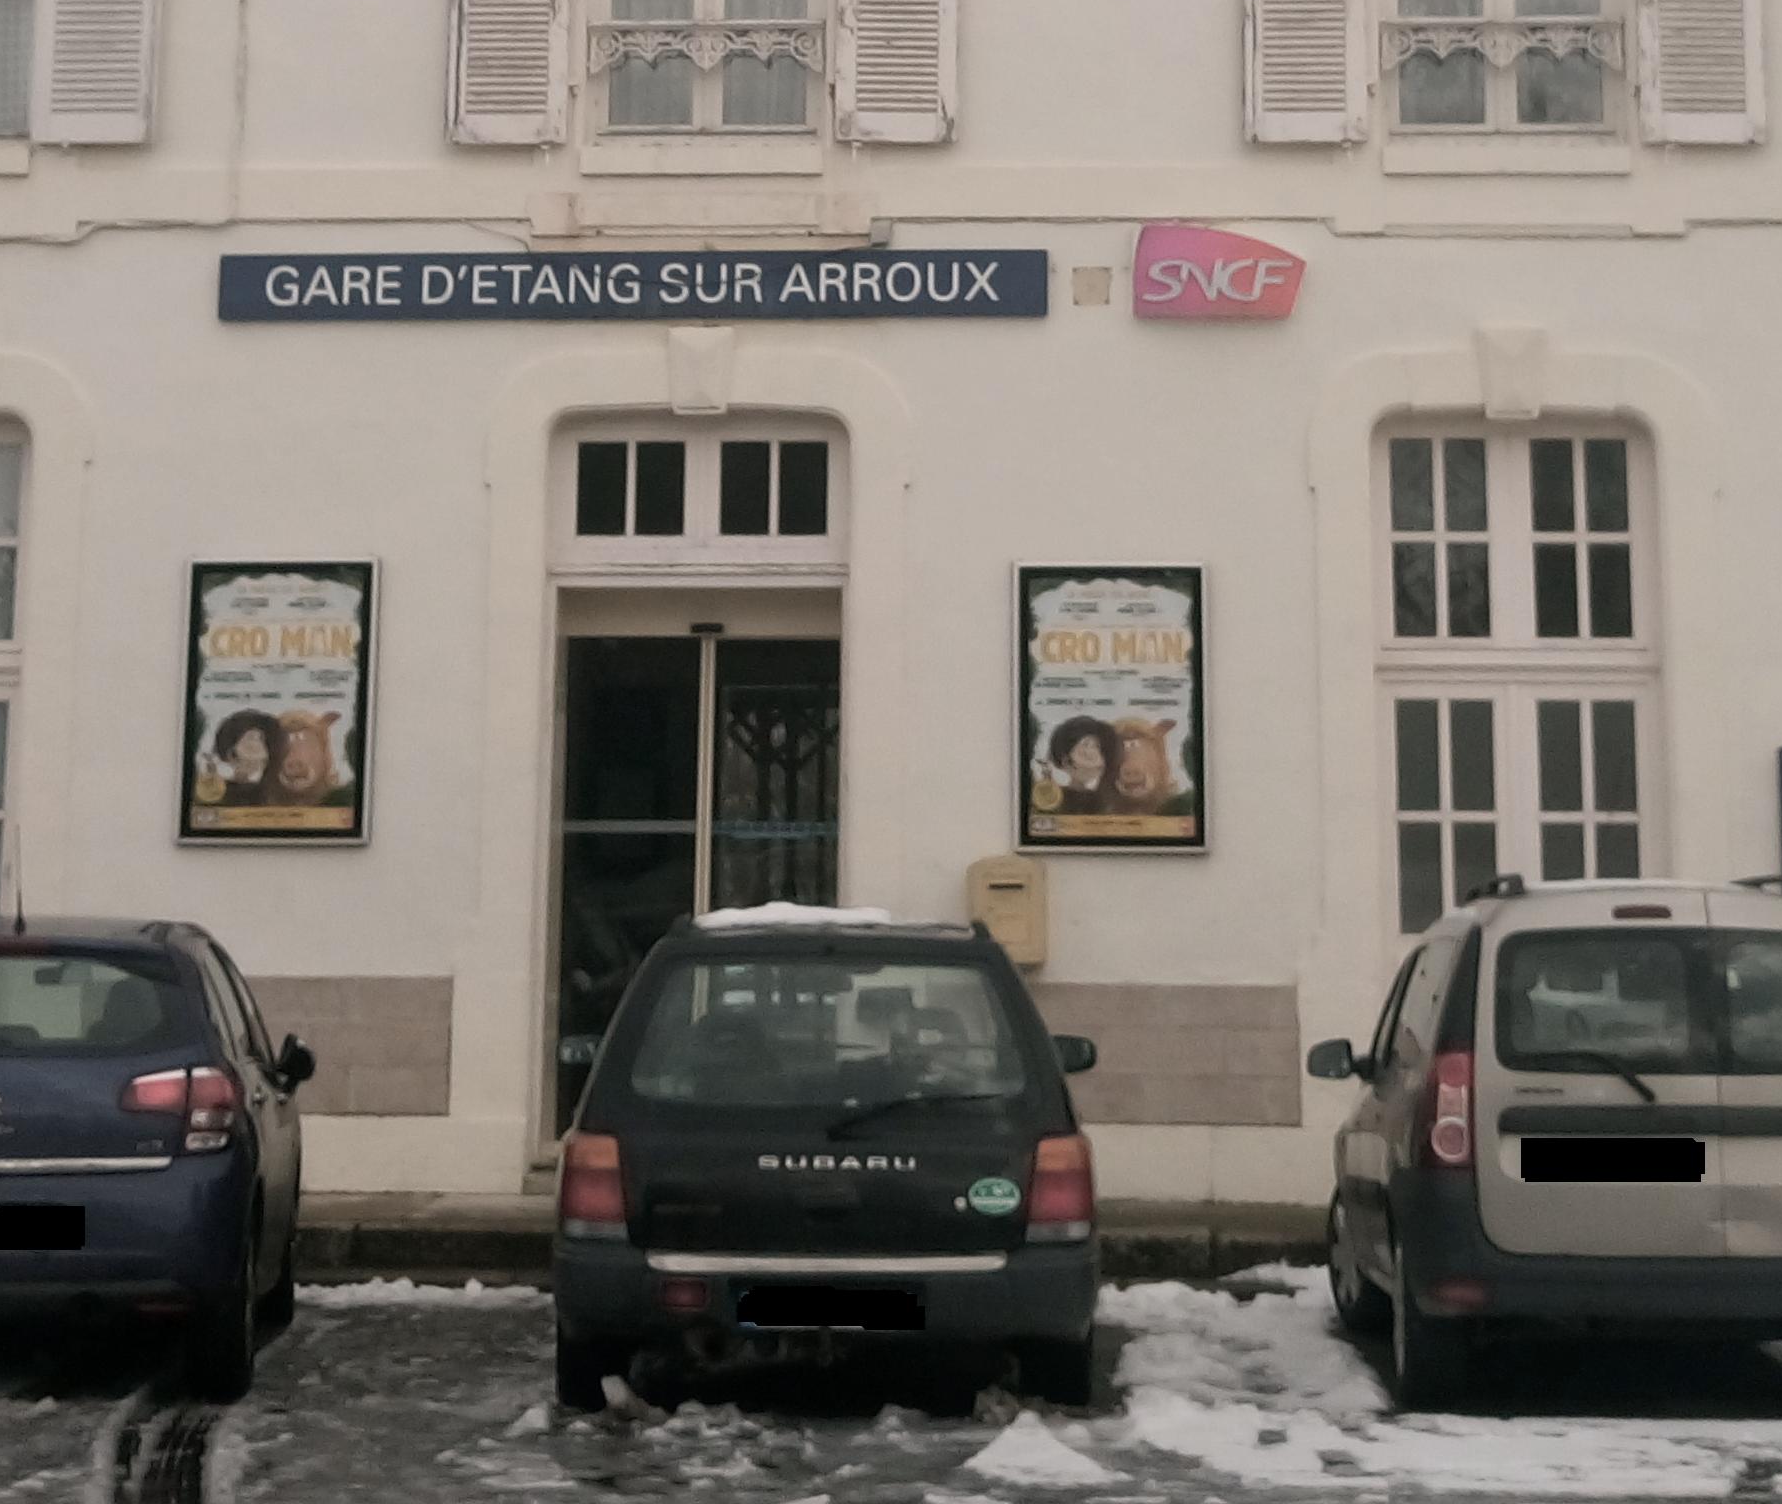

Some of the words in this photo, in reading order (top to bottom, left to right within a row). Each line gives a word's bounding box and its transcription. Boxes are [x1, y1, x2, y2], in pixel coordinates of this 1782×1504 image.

[265, 264, 404, 307] GARE
[421, 262, 641, 305] D'ETANG
[658, 262, 763, 304] SUR
[778, 260, 1000, 302] ARROUX
[1141, 257, 1293, 303] SNCF
[757, 1153, 917, 1172] SUBARU
